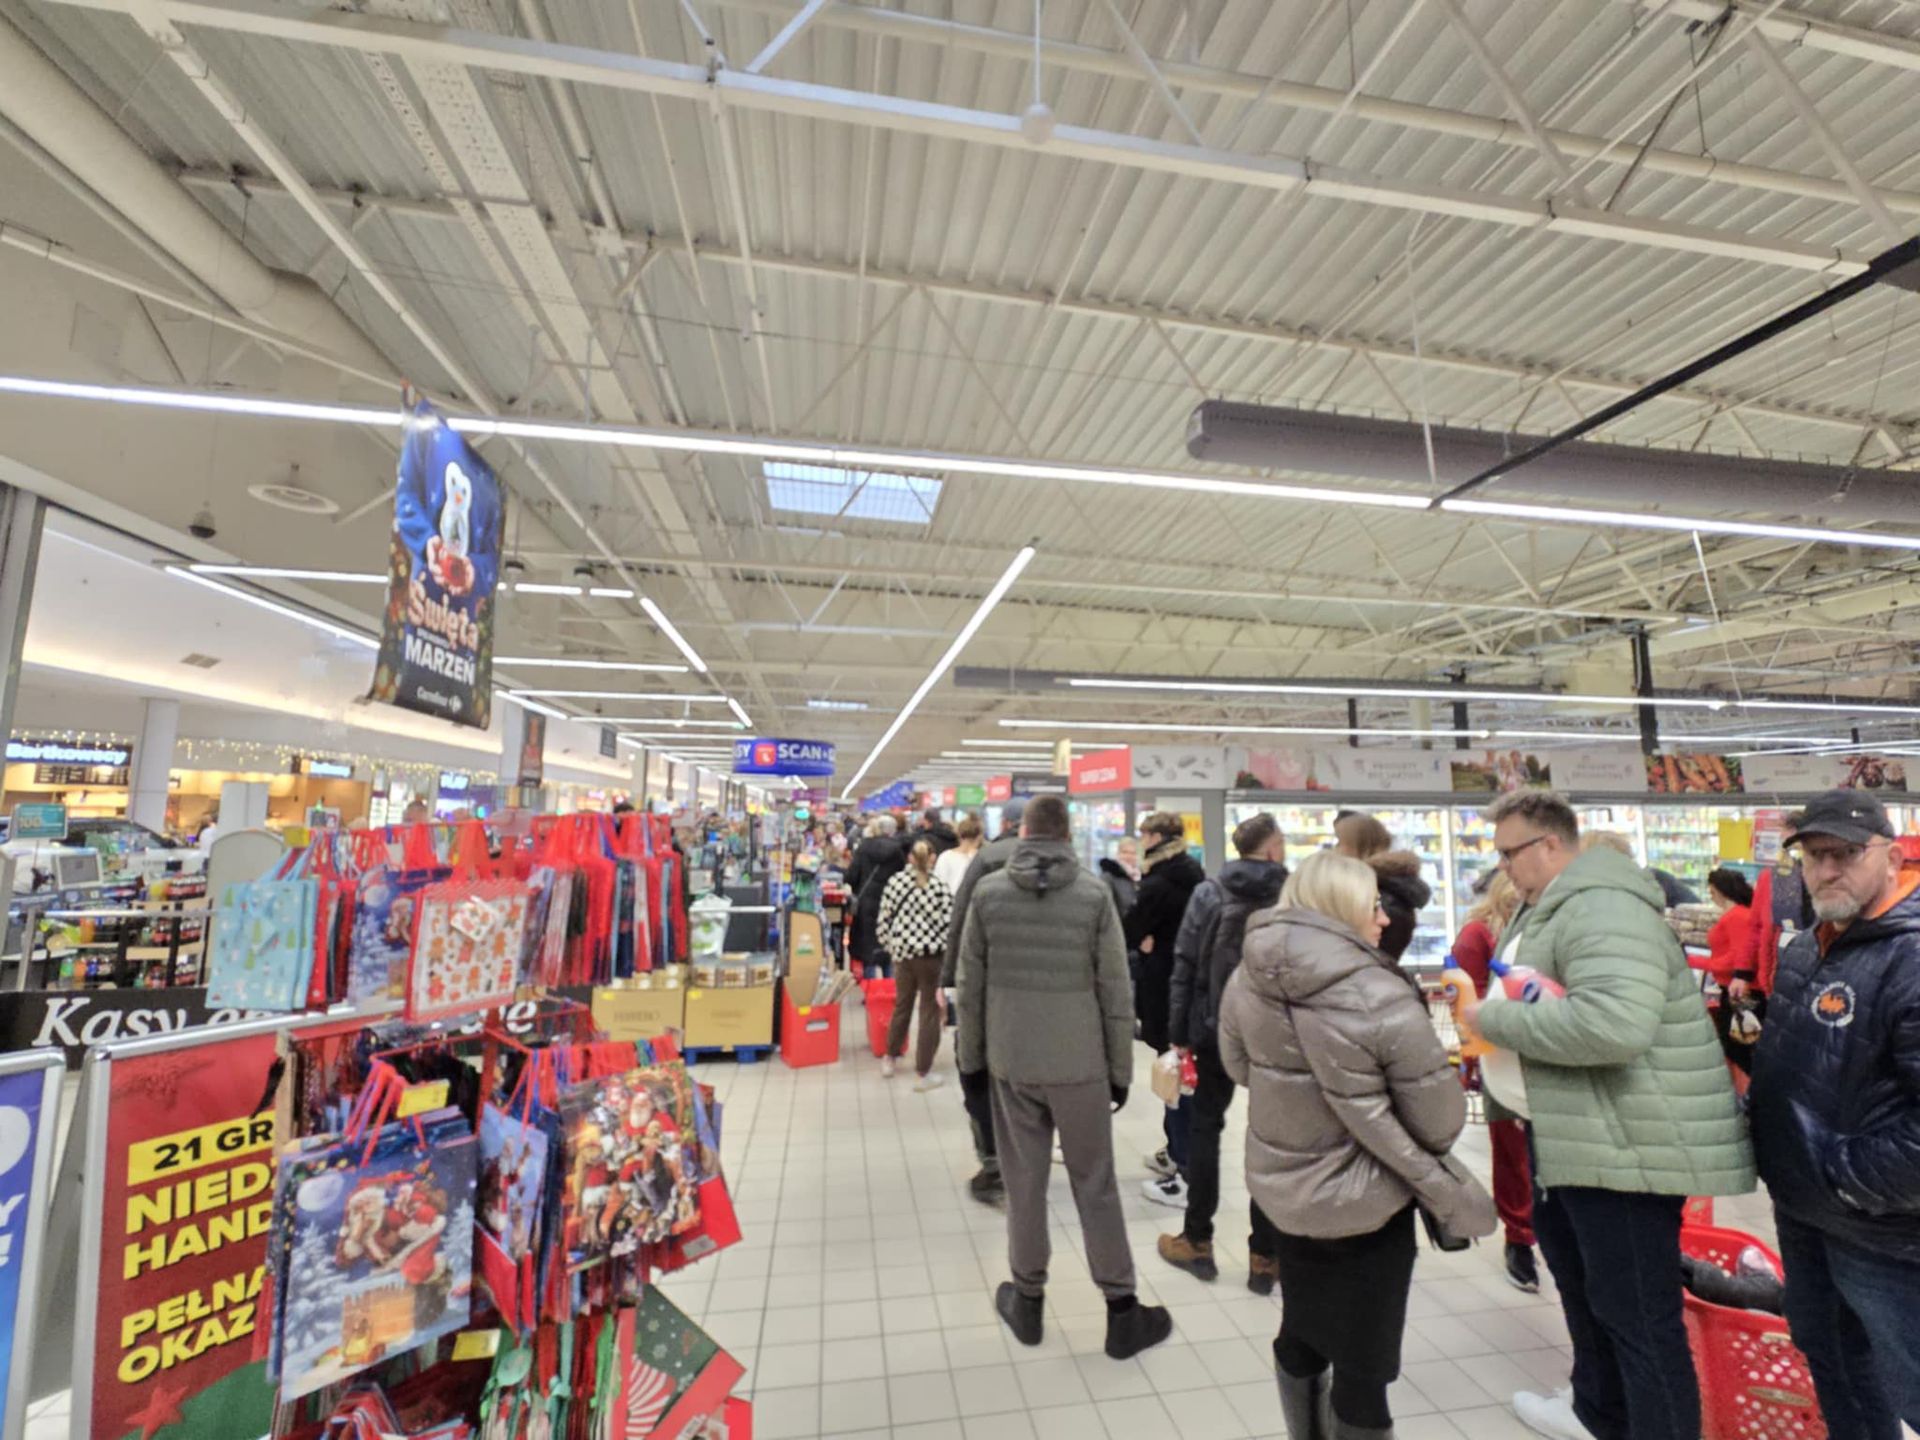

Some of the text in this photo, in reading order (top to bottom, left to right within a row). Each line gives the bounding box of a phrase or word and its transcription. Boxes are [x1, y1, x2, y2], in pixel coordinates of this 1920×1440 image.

[408, 571, 478, 651] Święta
[405, 634, 476, 686] MARZEŃ
[153, 1119, 273, 1170] 21 GR
[126, 1157, 276, 1234] NIED
[123, 1200, 273, 1280] HAND
[118, 1302, 256, 1384] OKAZ
